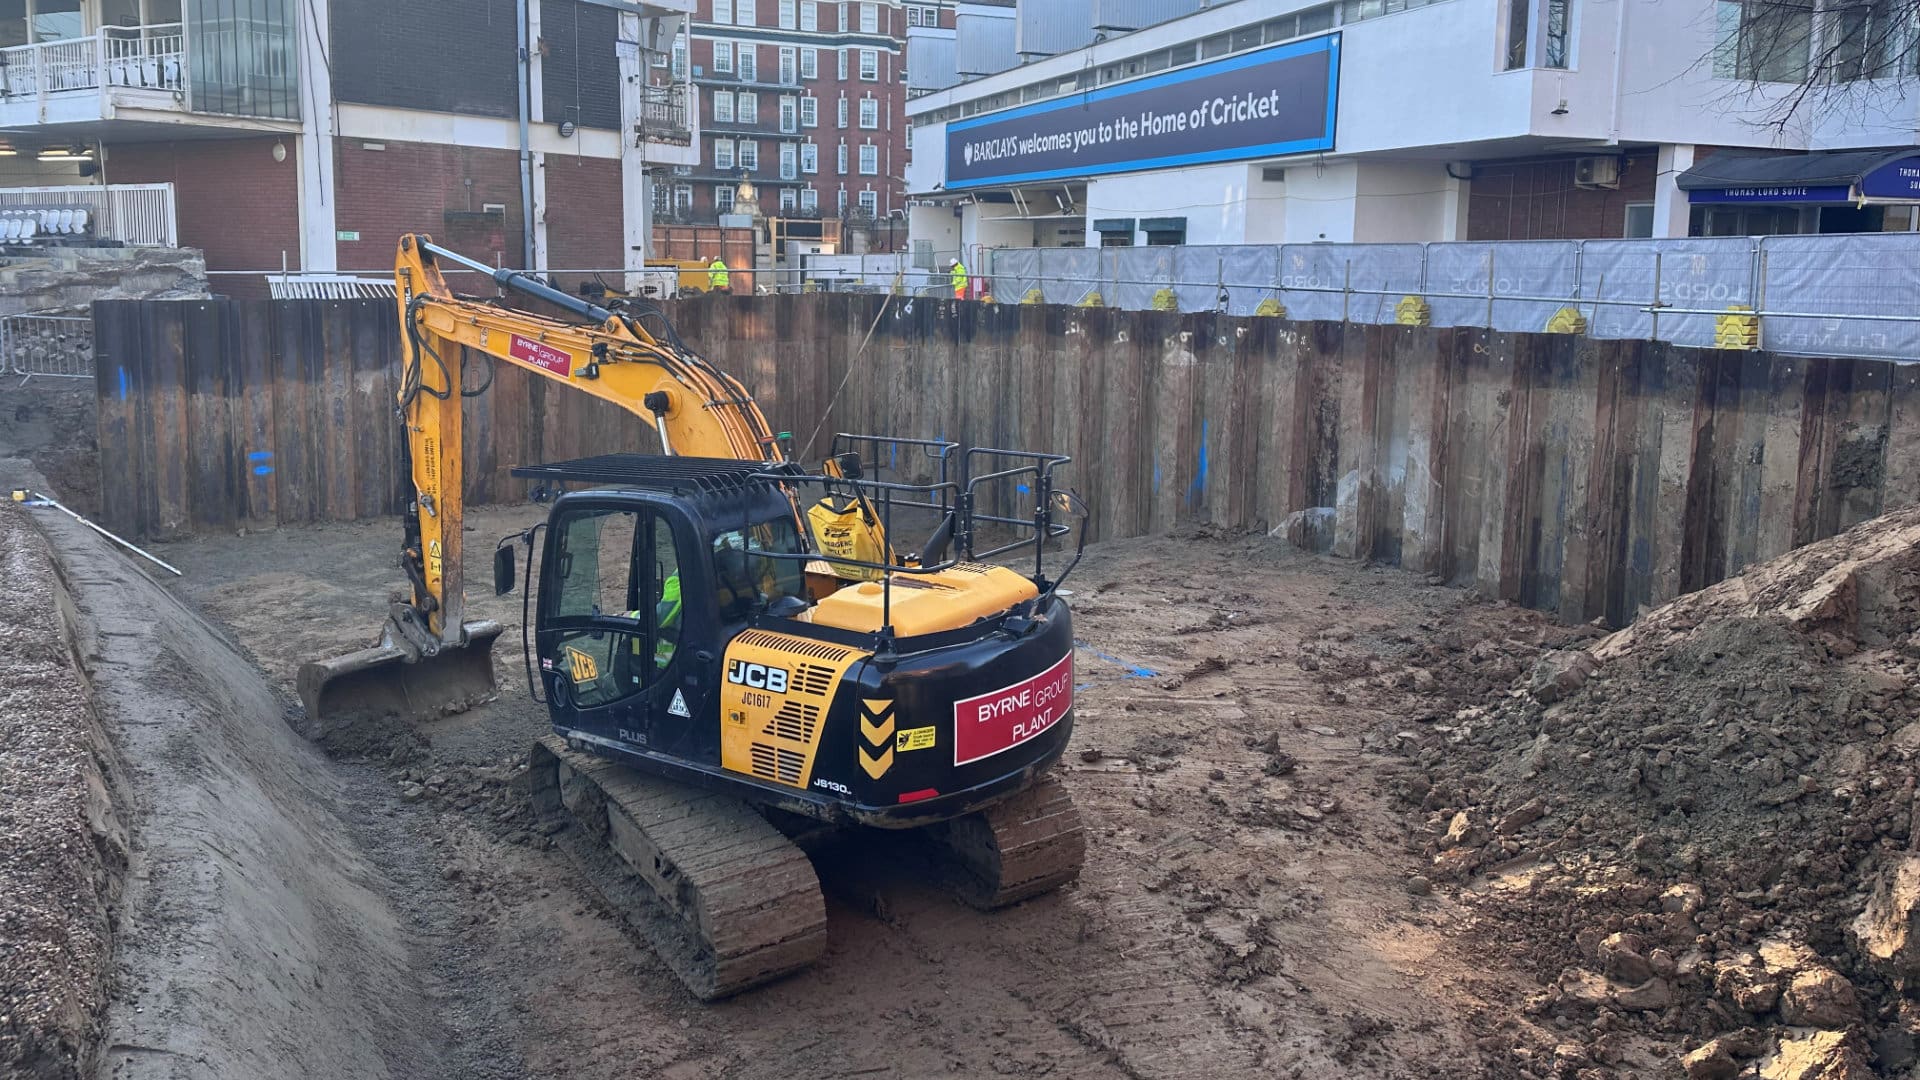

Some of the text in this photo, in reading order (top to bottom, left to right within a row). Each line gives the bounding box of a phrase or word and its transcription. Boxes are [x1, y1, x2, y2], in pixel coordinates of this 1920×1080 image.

[973, 89, 1280, 162] BARCLAYS welcomes you to the Home of Cricket
[1725, 187, 1807, 196] THOMAS LORD SUITE
[516, 338, 564, 364] BYRNE GROUP
[528, 355, 551, 368] PLANT
[571, 651, 597, 681] JCB
[728, 661, 788, 693] JCB
[741, 691, 771, 709] JC1617
[978, 672, 1068, 722] BYRNE GROUP
[619, 728, 647, 744] PLUS
[1012, 707, 1053, 742] PLANT
